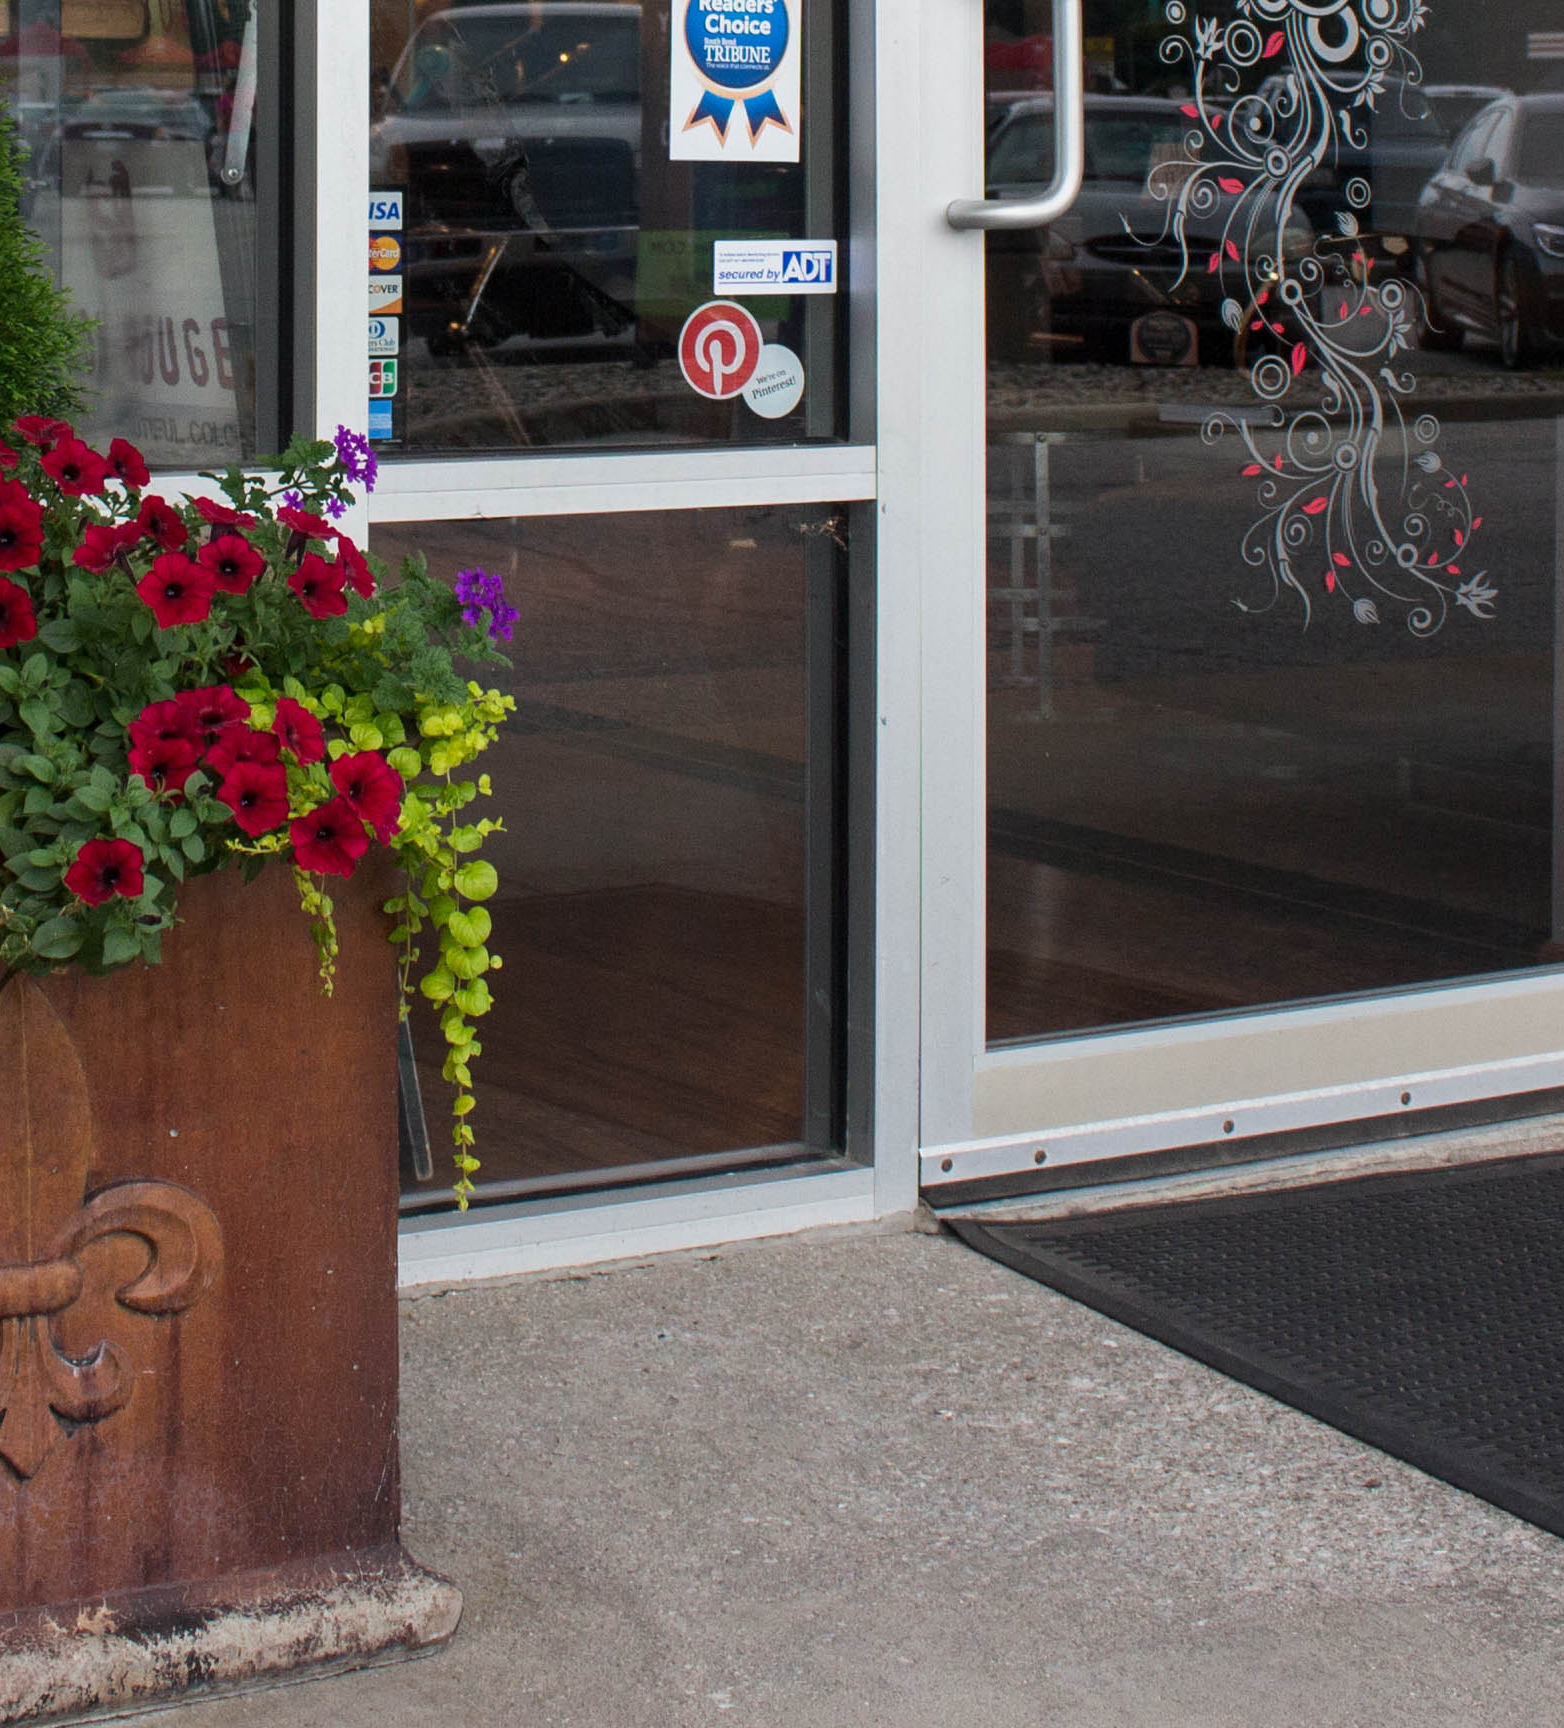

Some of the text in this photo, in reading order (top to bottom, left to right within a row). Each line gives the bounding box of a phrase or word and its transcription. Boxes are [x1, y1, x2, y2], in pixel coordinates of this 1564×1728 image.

[704, 13, 772, 35] Choice
[703, 45, 771, 63] TRIBUNE
[368, 202, 400, 220] ISA
[718, 269, 764, 280] secured
[766, 268, 781, 282] by
[782, 252, 832, 282] ADT
[369, 371, 394, 385] CB
[751, 375, 797, 400] Pinterest!
